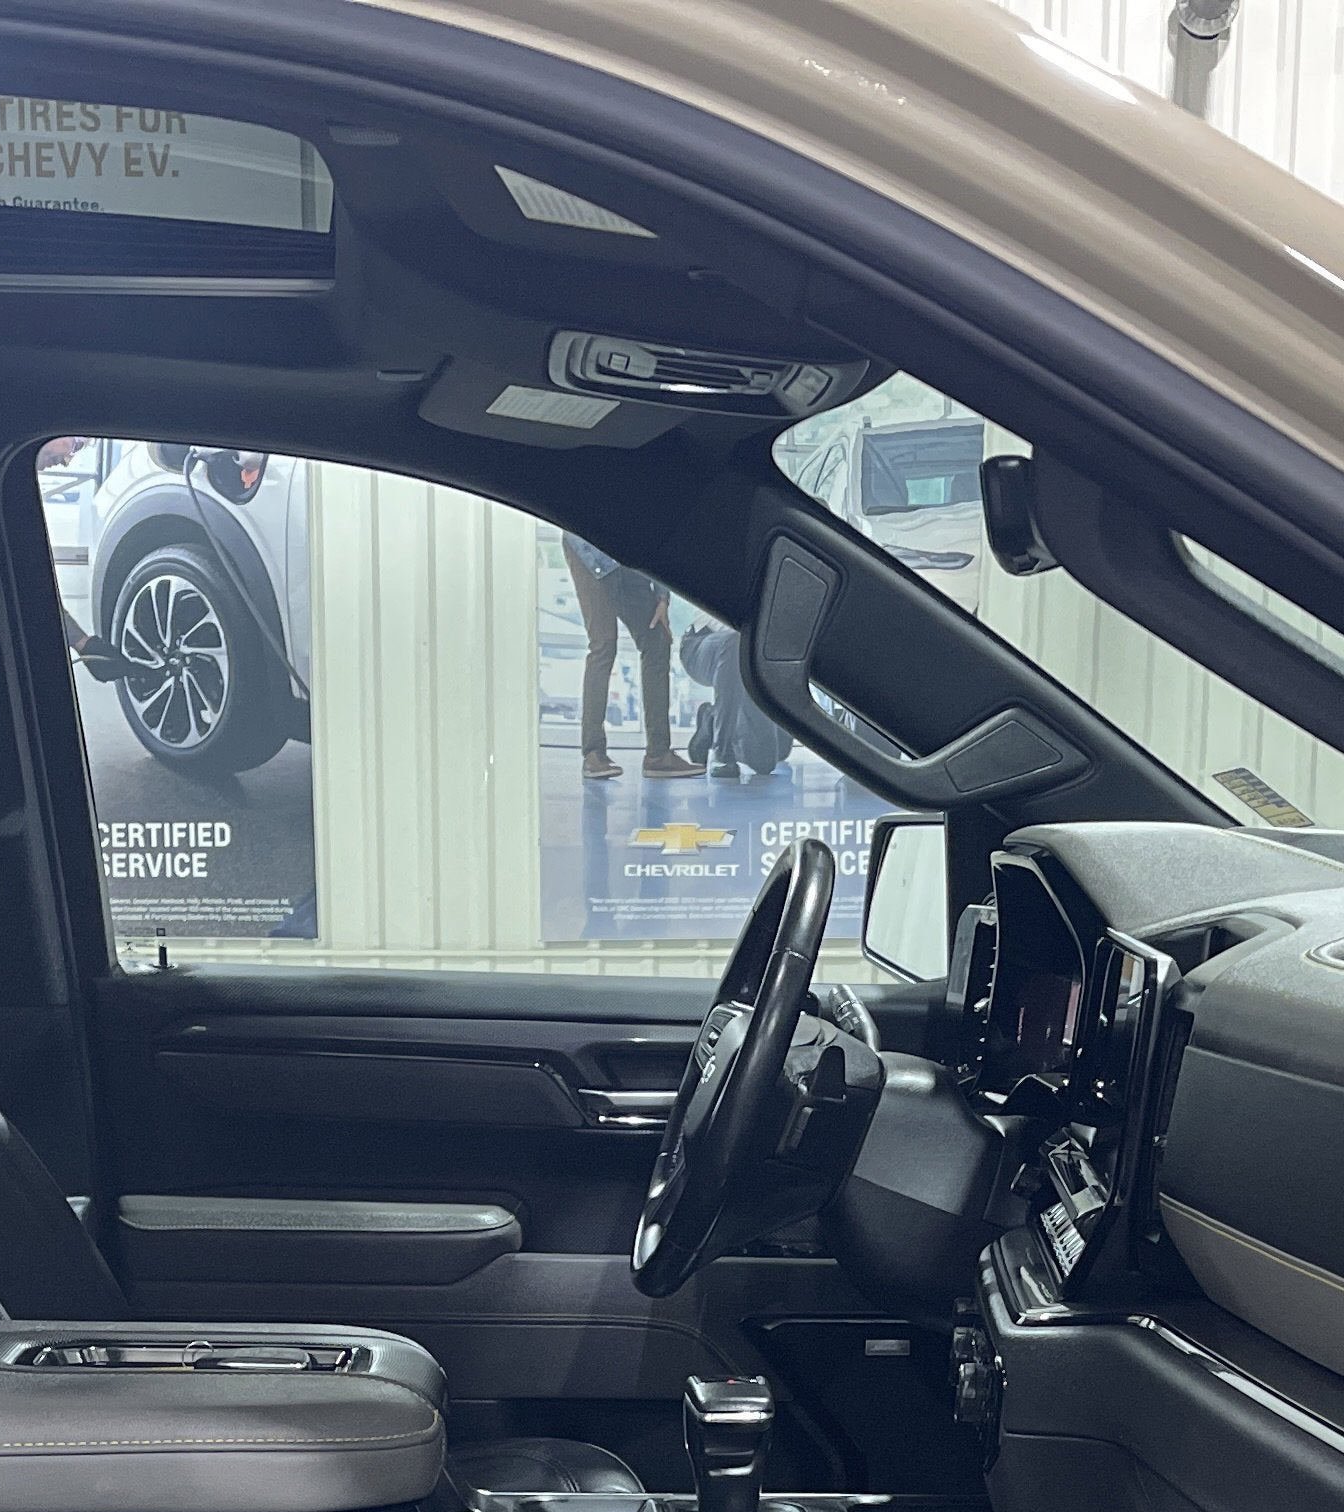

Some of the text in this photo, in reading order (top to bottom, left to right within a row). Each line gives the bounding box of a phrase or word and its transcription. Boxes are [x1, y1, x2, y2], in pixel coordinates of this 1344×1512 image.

[115, 106, 187, 134] FOR
[124, 142, 180, 178] EV.
[12, 195, 105, 212] Guarantee.
[97, 821, 233, 848] CERTIFIED
[623, 863, 741, 878] CHEVROLET
